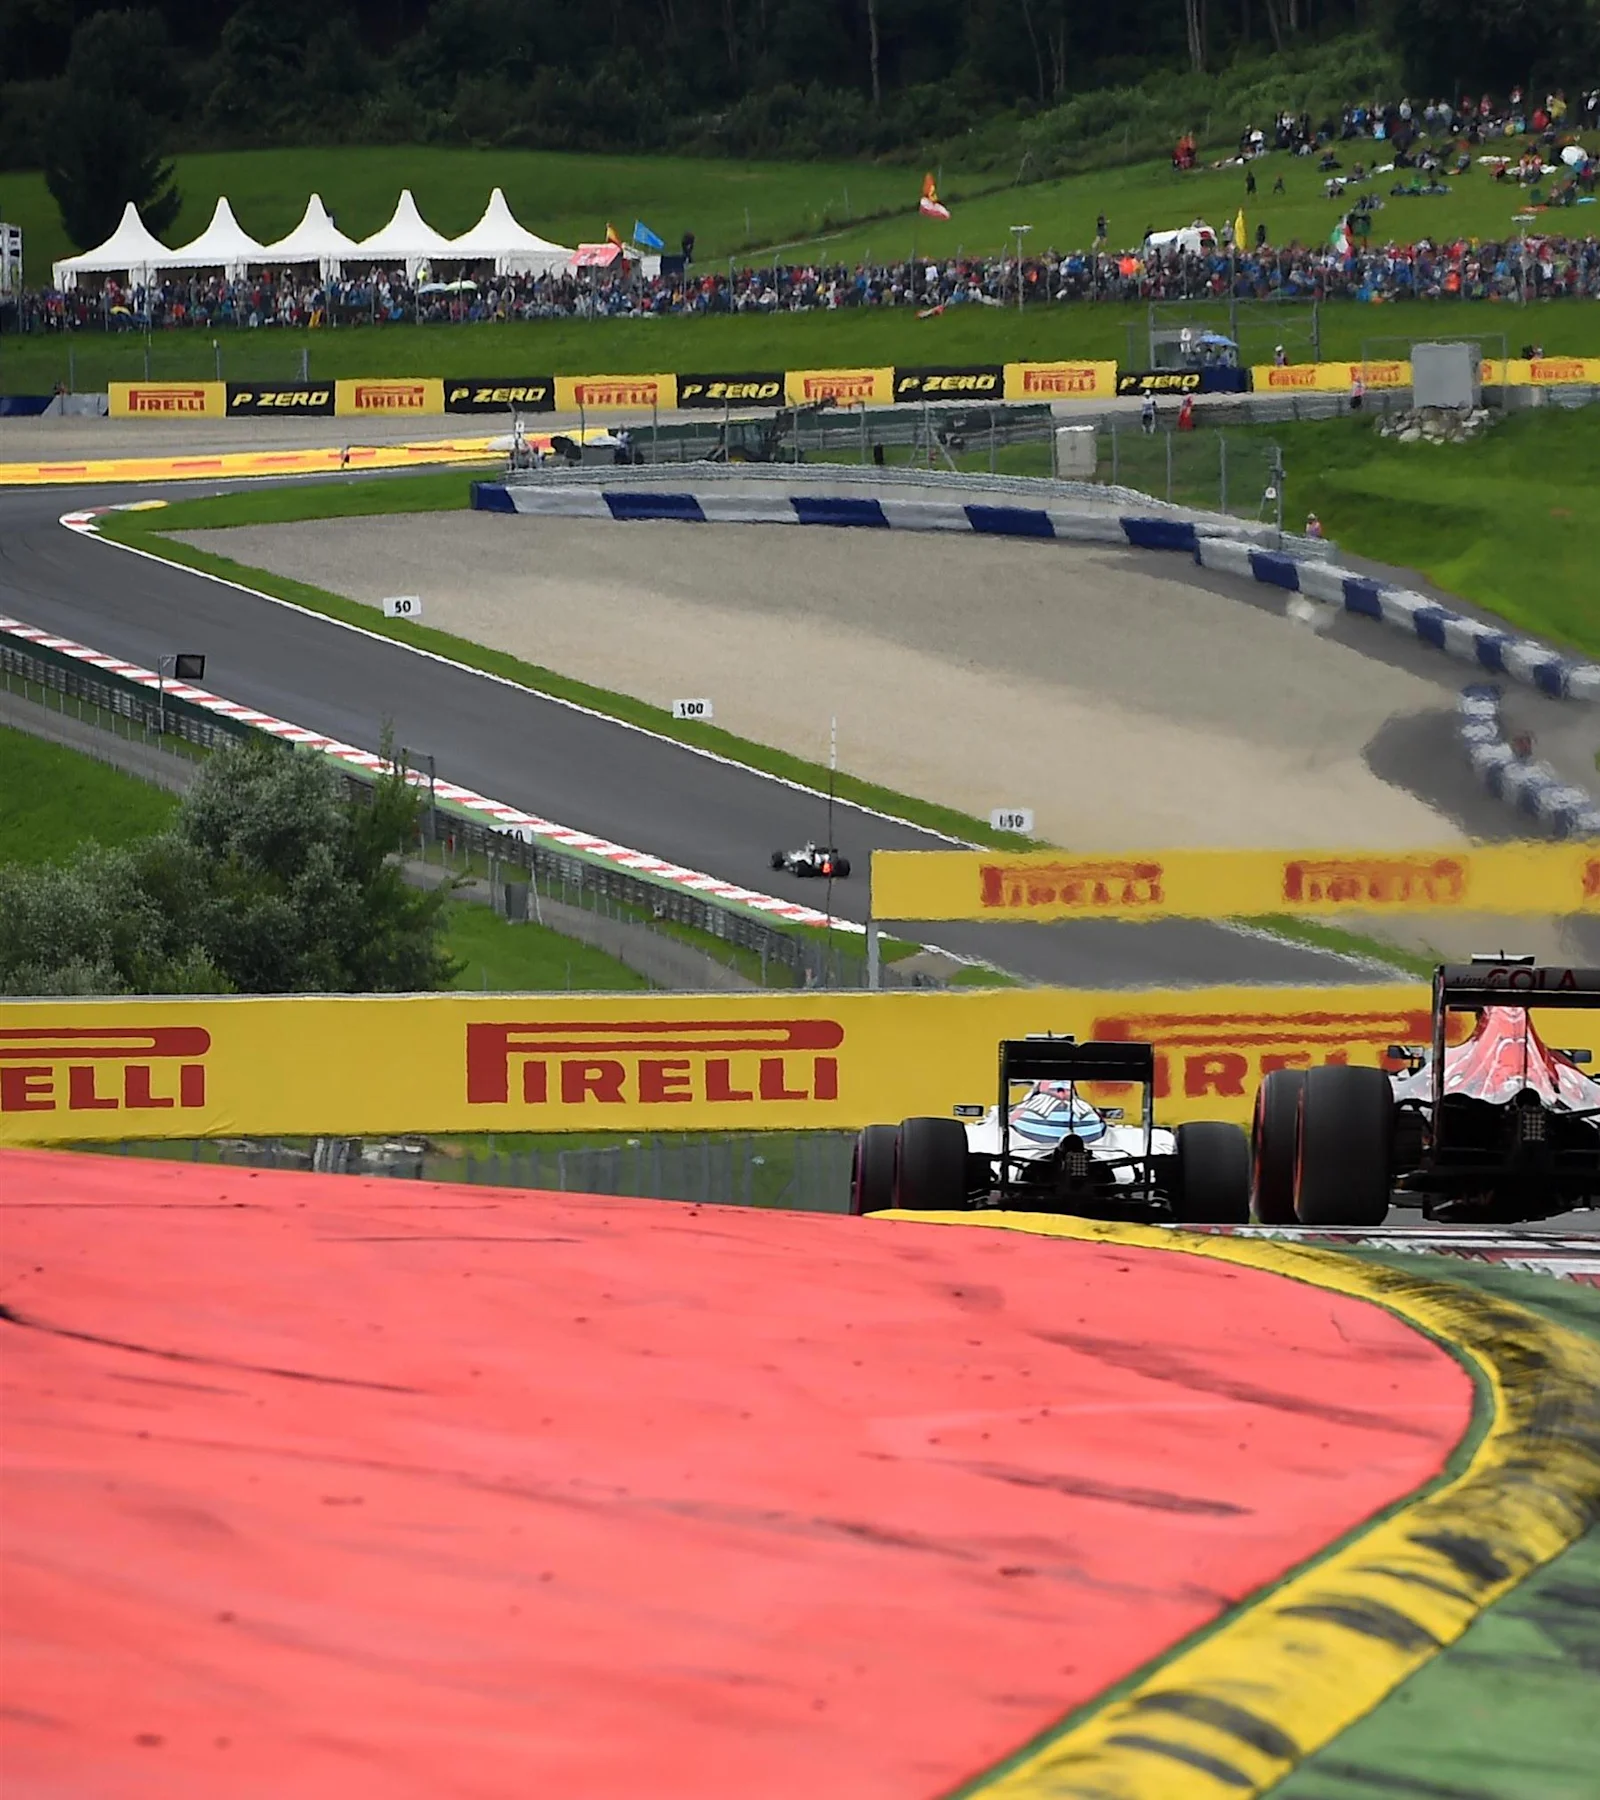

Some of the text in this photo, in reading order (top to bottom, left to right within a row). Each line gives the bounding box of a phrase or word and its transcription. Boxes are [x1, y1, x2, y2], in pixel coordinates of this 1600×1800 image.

[804, 376, 873, 398] PIRELLI
[898, 375, 997, 393] P ZERO
[1024, 369, 1095, 393] PIRELLI
[1119, 374, 1200, 391] P ZERO
[232, 391, 329, 407] P ZERO
[355, 386, 424, 408] PIRELLI
[450, 387, 546, 403] P ZERO
[575, 383, 658, 405] PIRELLI
[682, 382, 780, 399] P ZERO
[129, 390, 205, 411] PIRELLI
[395, 600, 412, 613] 50
[680, 702, 704, 716] 100
[467, 1019, 844, 1104] PIRELLI
